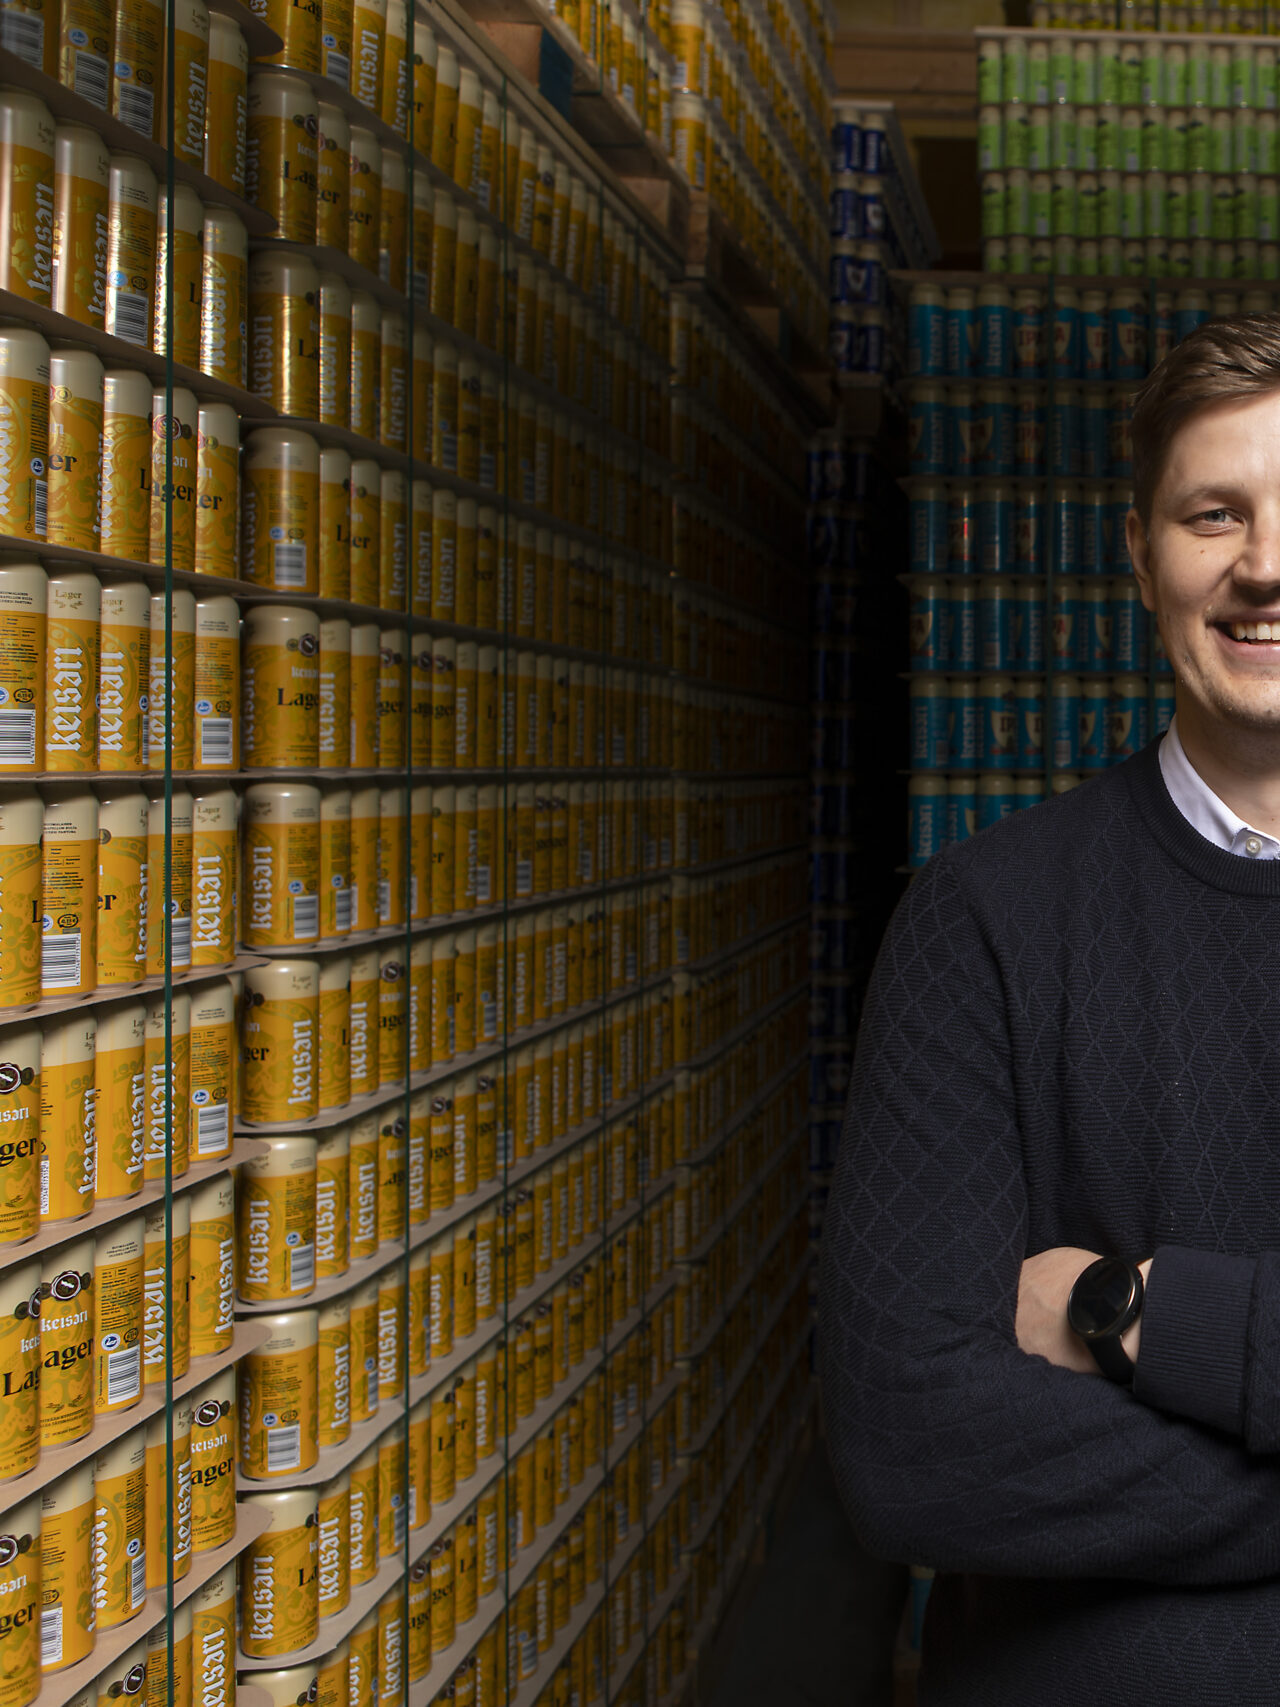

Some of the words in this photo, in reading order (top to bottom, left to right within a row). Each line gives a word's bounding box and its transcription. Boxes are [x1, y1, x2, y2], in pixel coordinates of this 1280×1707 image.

[55, 589, 82, 600] Lager
[46, 647, 83, 751] keisari
[100, 651, 125, 752] keisari
[193, 855, 222, 949] keisari
[251, 845, 273, 930] keisari
[288, 1018, 312, 1105] keisari
[350, 1001, 367, 1079] keisari
[245, 1200, 270, 1285] keisari
[354, 1162, 375, 1244] keisari
[41, 1310, 89, 1332] keisari
[214, 1238, 232, 1335] keisari
[43, 1337, 94, 1370] ager
[330, 1343, 350, 1428] keisari
[378, 1306, 397, 1385] keisari
[250, 1554, 274, 1641] keisari
[318, 1516, 340, 1602] keisari
[202, 1627, 225, 1707] eisari
[382, 1617, 401, 1699] keisari
